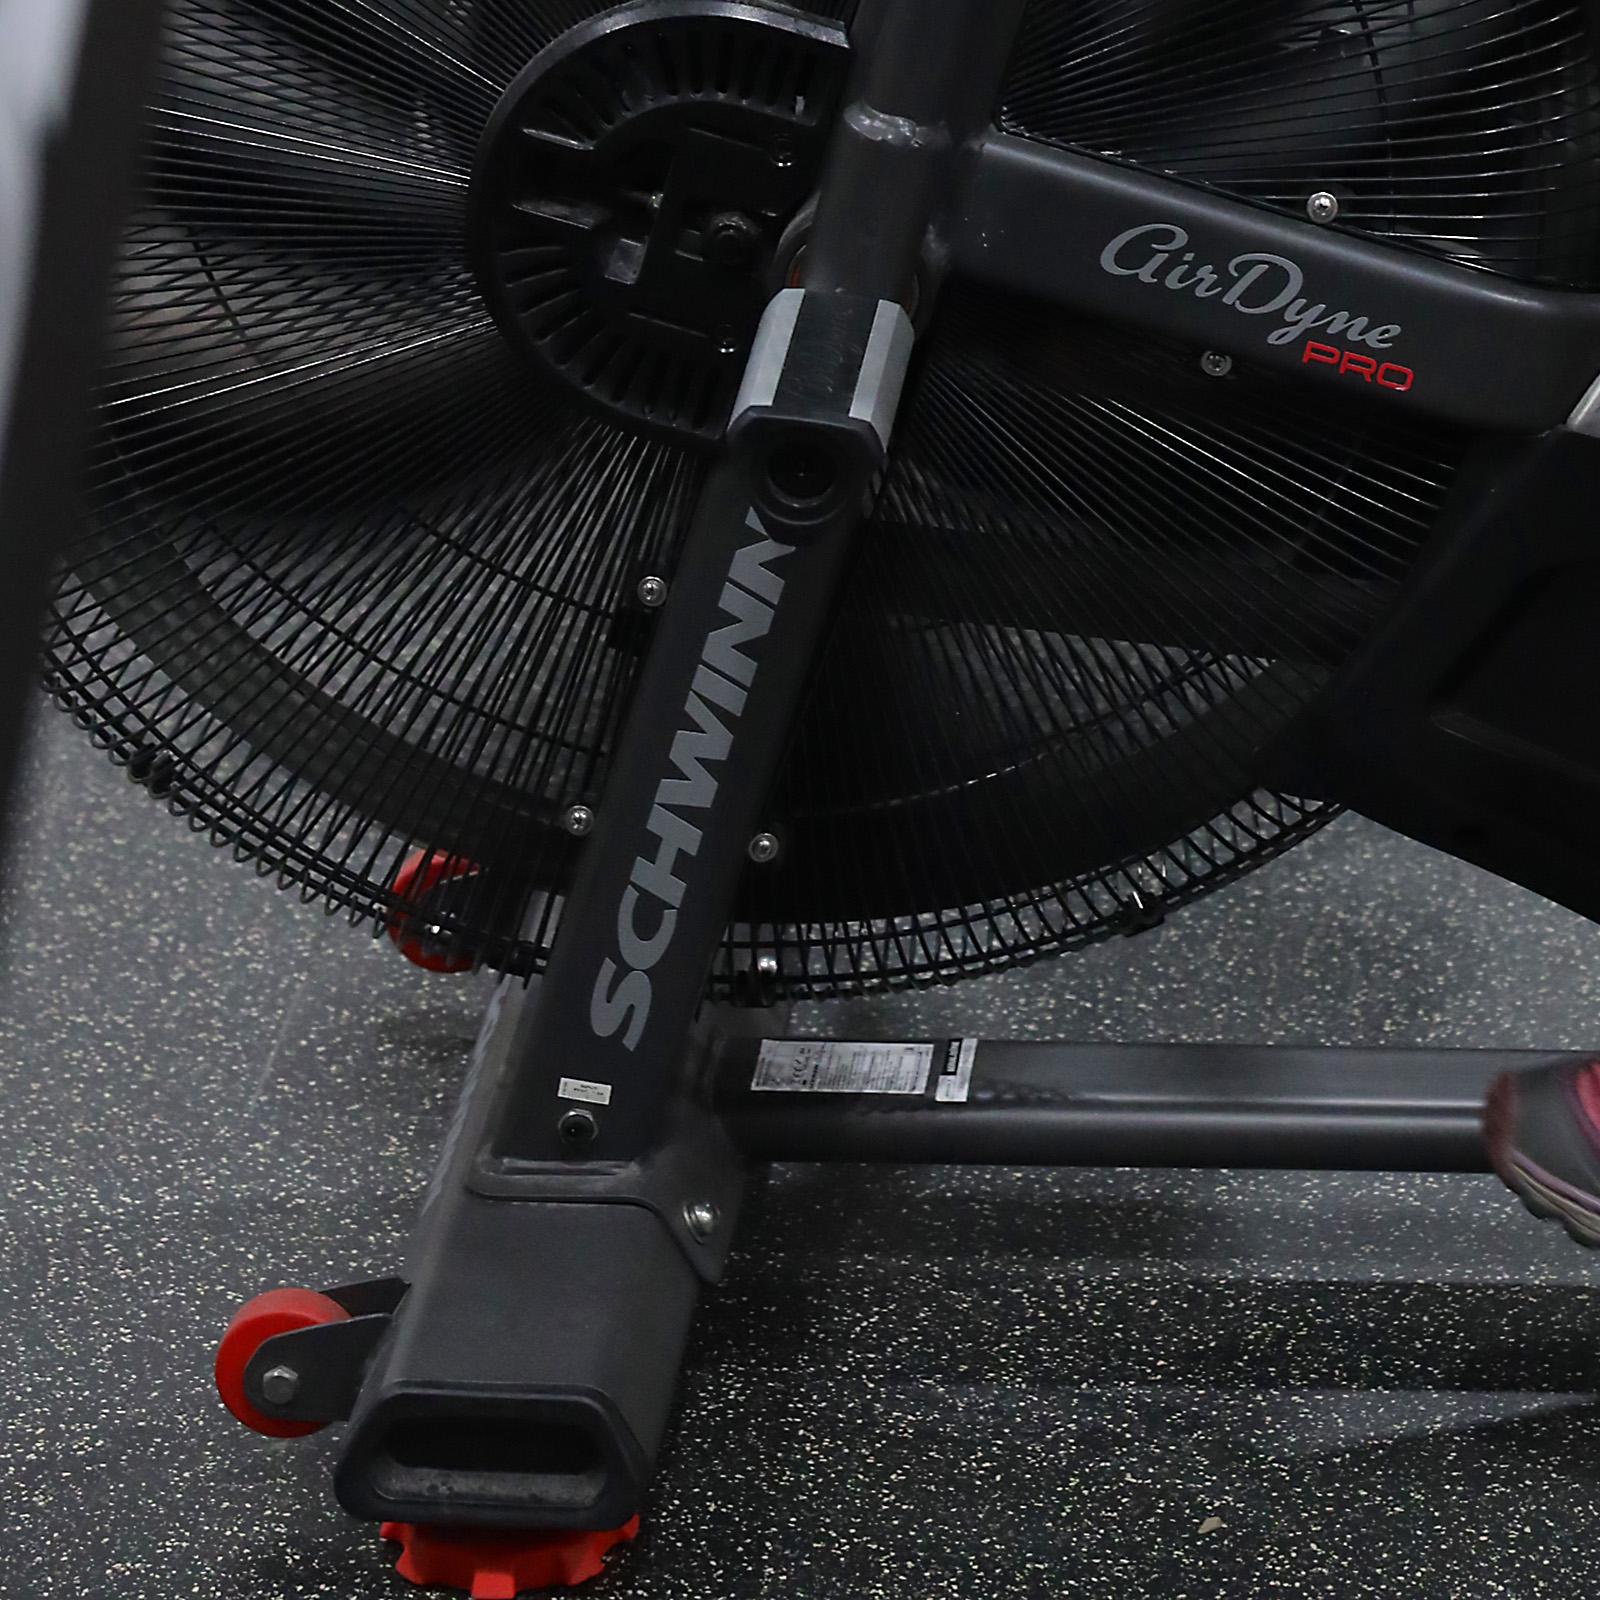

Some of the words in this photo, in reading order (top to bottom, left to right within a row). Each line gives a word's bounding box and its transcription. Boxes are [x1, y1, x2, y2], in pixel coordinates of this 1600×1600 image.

[1100, 223, 1401, 348] AirDyne
[1302, 341, 1414, 391] PRO
[590, 506, 796, 1051] SCHWINN
